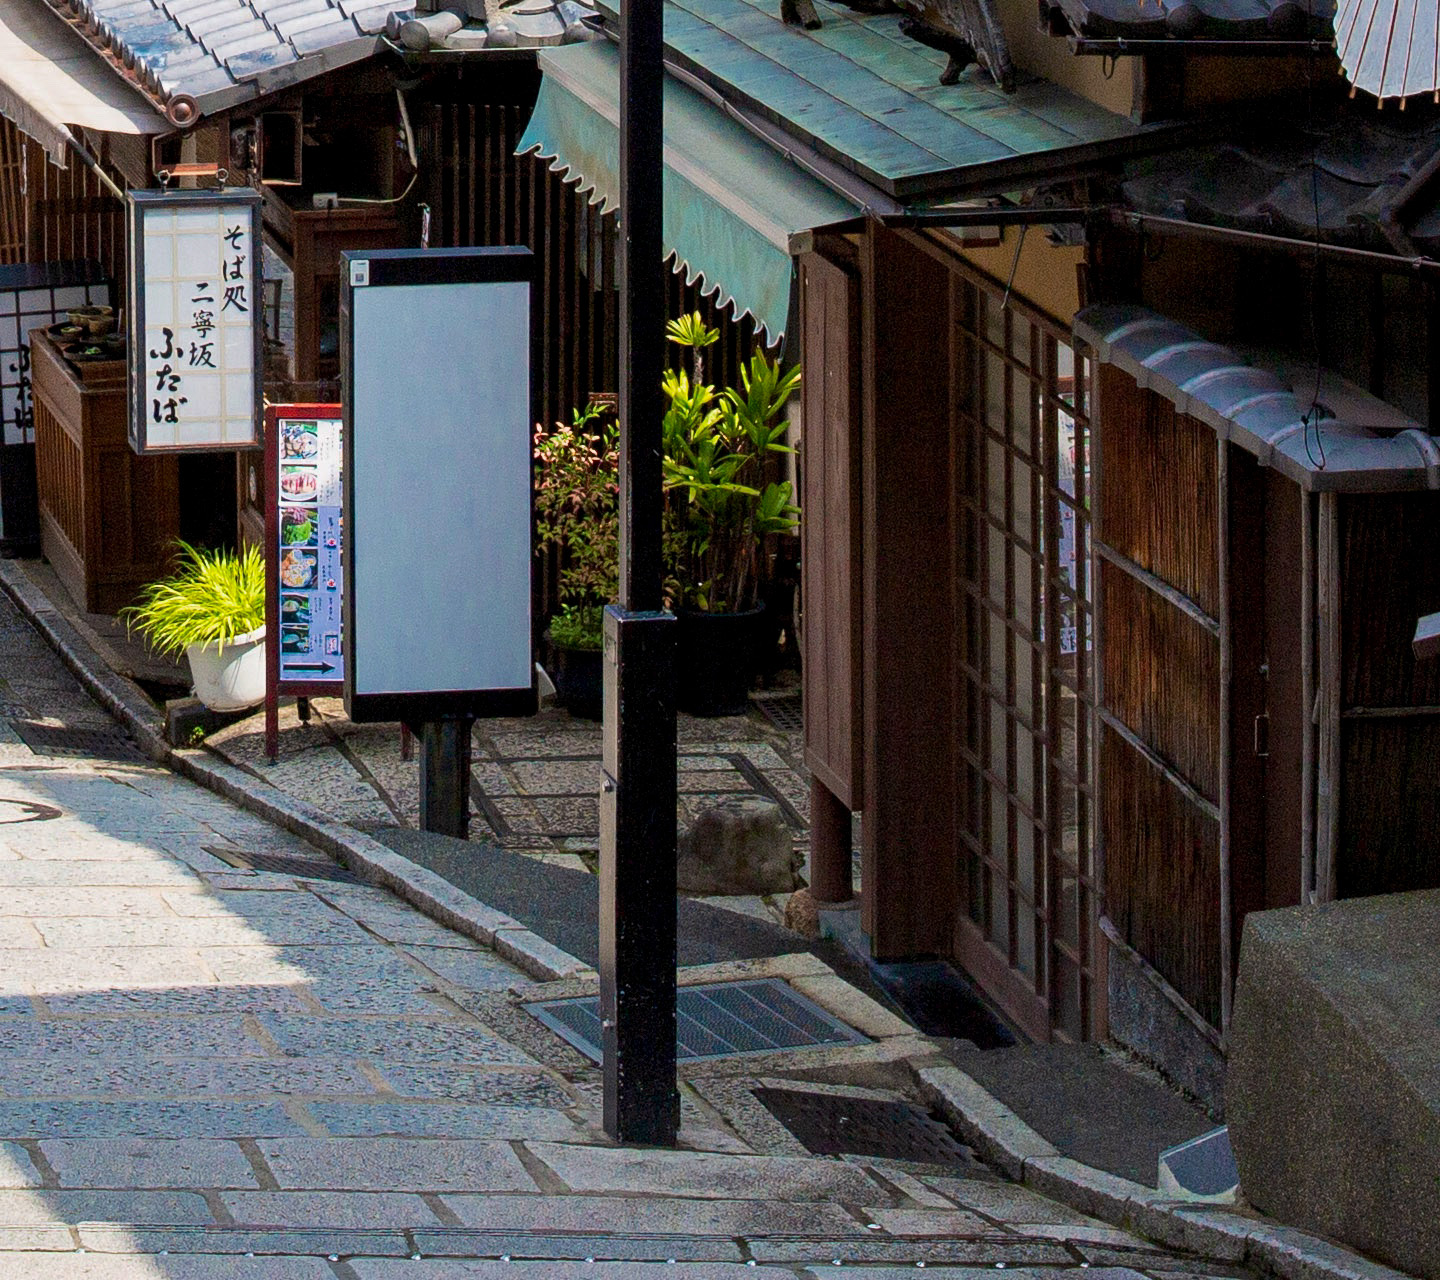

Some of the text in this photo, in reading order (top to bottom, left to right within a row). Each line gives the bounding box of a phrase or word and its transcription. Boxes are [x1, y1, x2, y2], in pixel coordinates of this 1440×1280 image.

[220, 224, 249, 313] そば処
[188, 282, 217, 369] 二寧坂
[149, 327, 188, 424] ふたば
